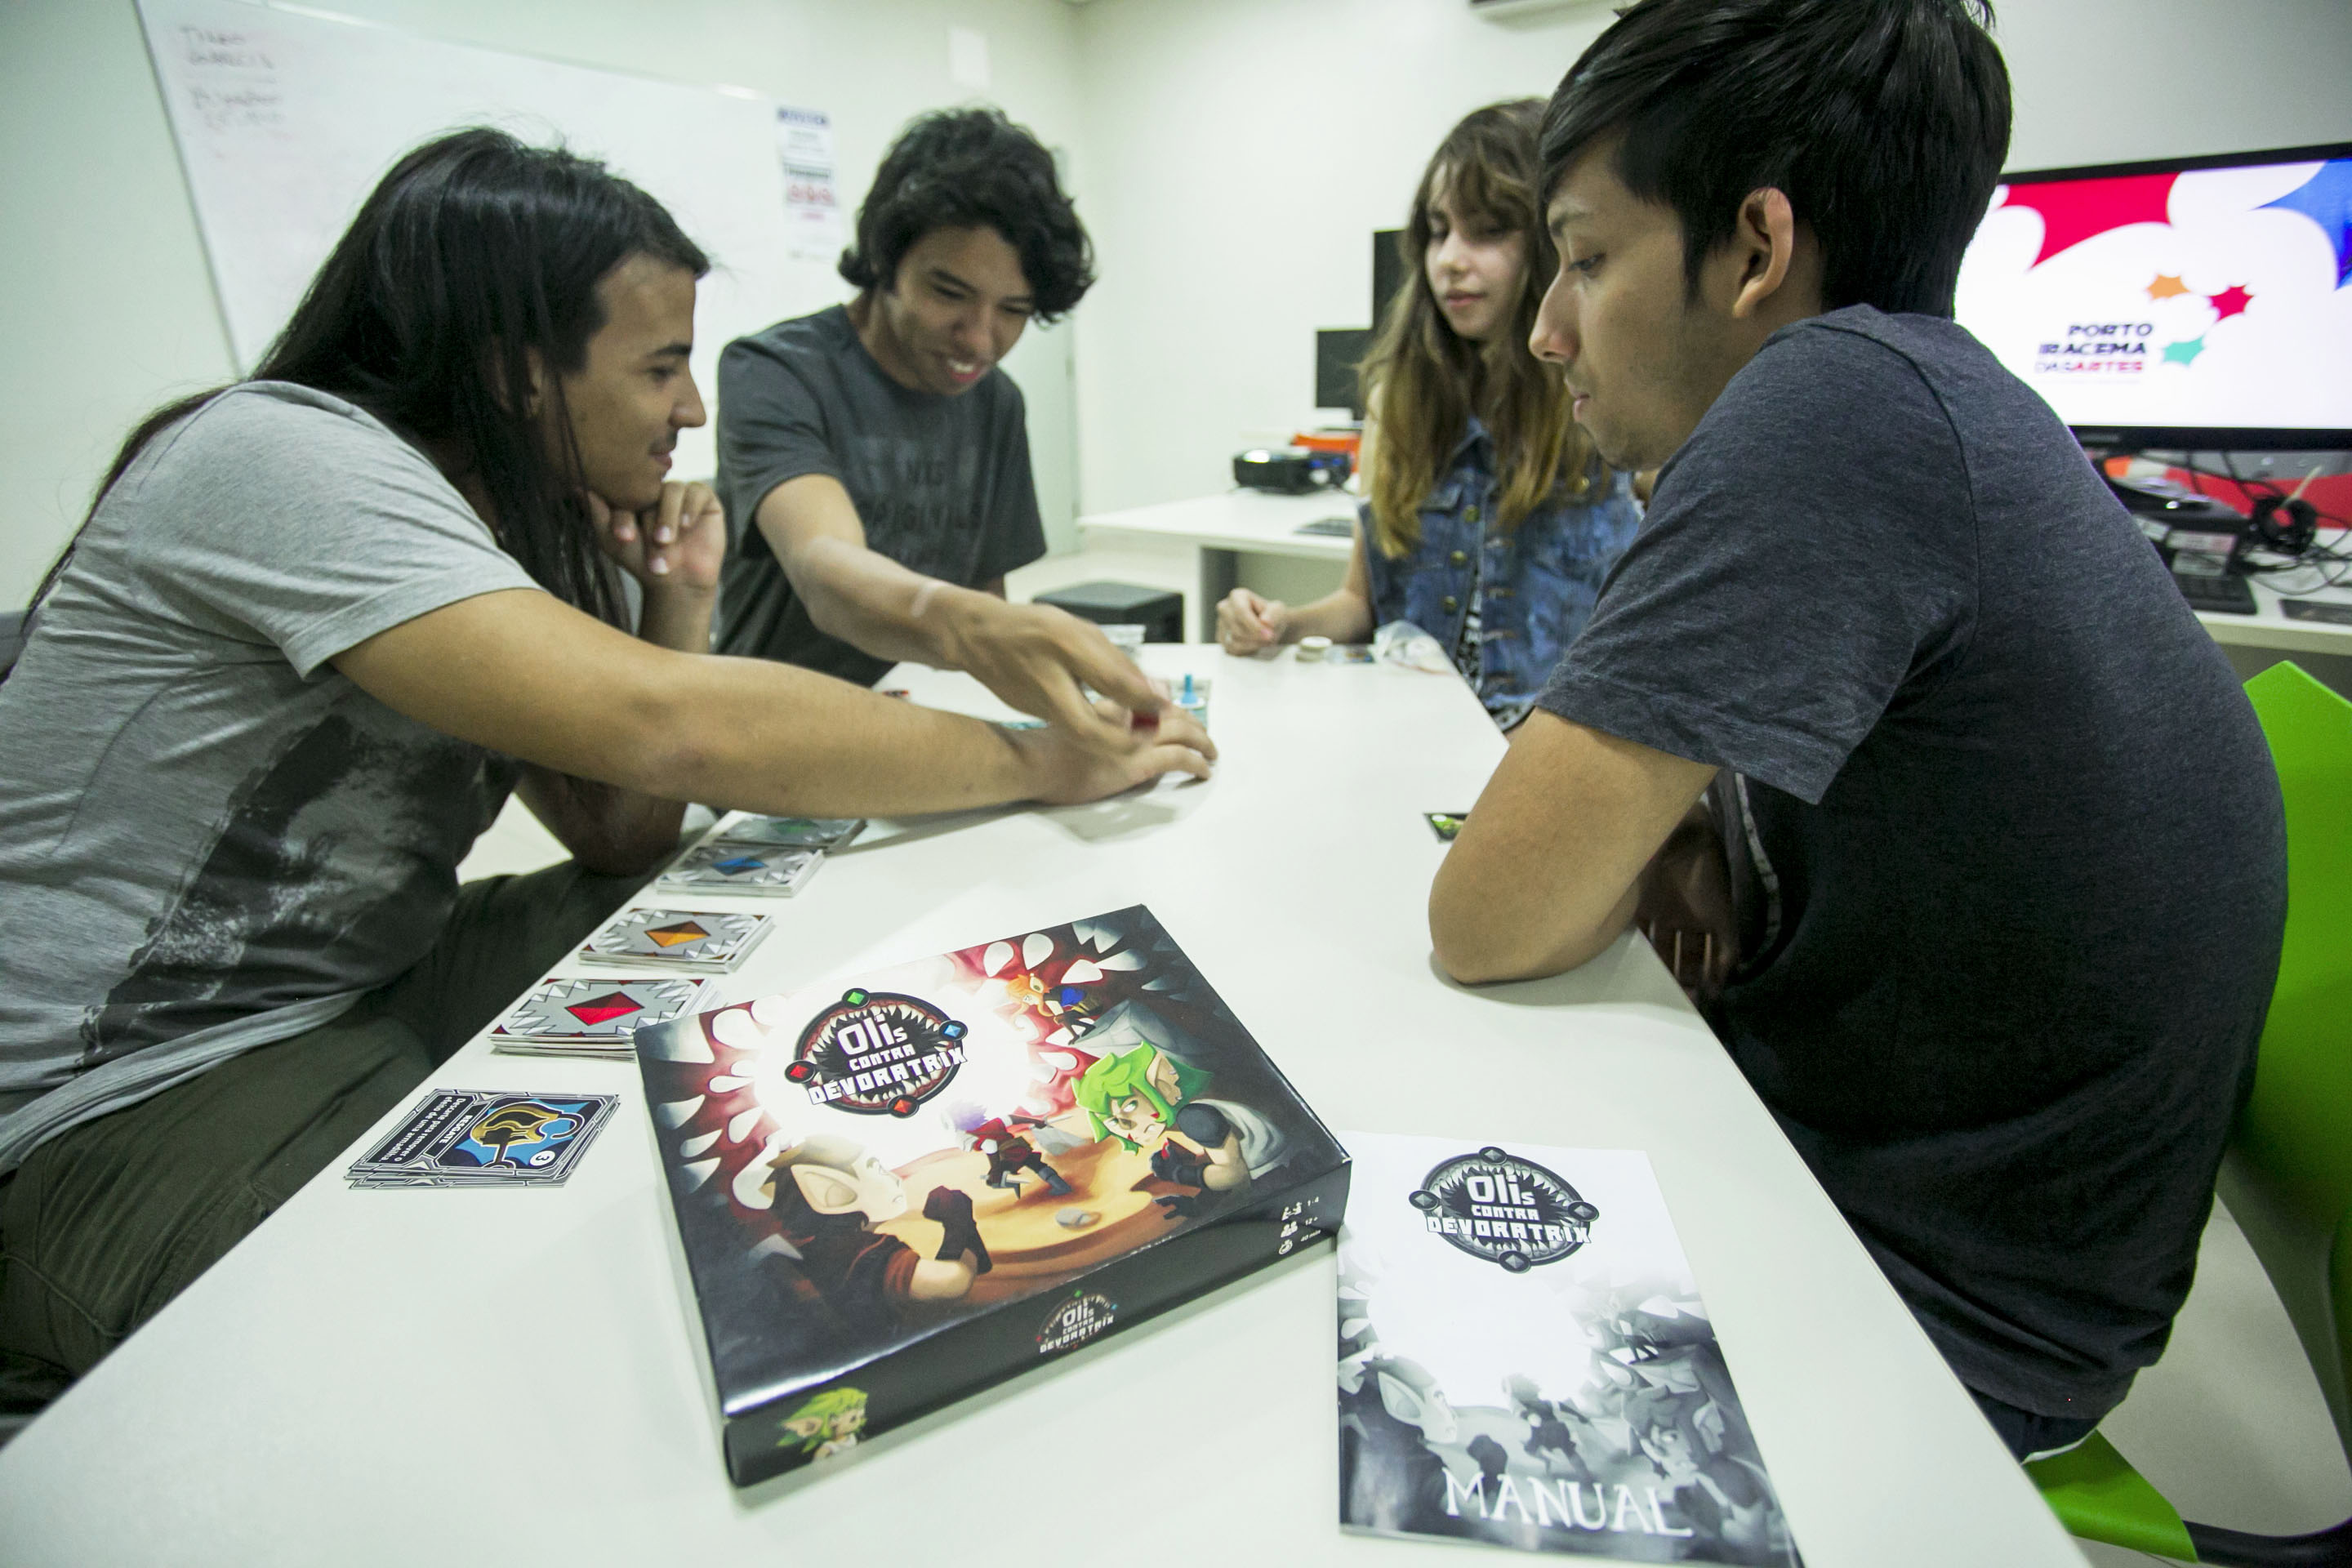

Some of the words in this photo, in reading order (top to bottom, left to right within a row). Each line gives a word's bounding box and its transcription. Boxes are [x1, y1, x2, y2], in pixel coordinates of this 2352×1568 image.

[2069, 323, 2153, 336] PORTO
[2038, 342, 2147, 354] IRACEMA
[837, 1013, 907, 1055] Olis
[849, 1044, 915, 1071] CONTRA
[807, 1047, 968, 1105] DEVORATRIX
[434, 1096, 452, 1111] efeito
[438, 1098, 466, 1120] Descarte
[412, 1120, 429, 1132] uma
[425, 1111, 439, 1120] de
[425, 1120, 440, 1135] para
[439, 1115, 473, 1144] RESGATE
[400, 1134, 427, 1156] remover
[1466, 1174, 1536, 1205] Olis
[1471, 1205, 1540, 1221] CONTRA
[1427, 1216, 1592, 1243] DEVORATRIX
[1062, 1303, 1094, 1326] Olis
[1040, 1315, 1114, 1353] DEVORATRIX
[1442, 1467, 1695, 1538] MANUAL
